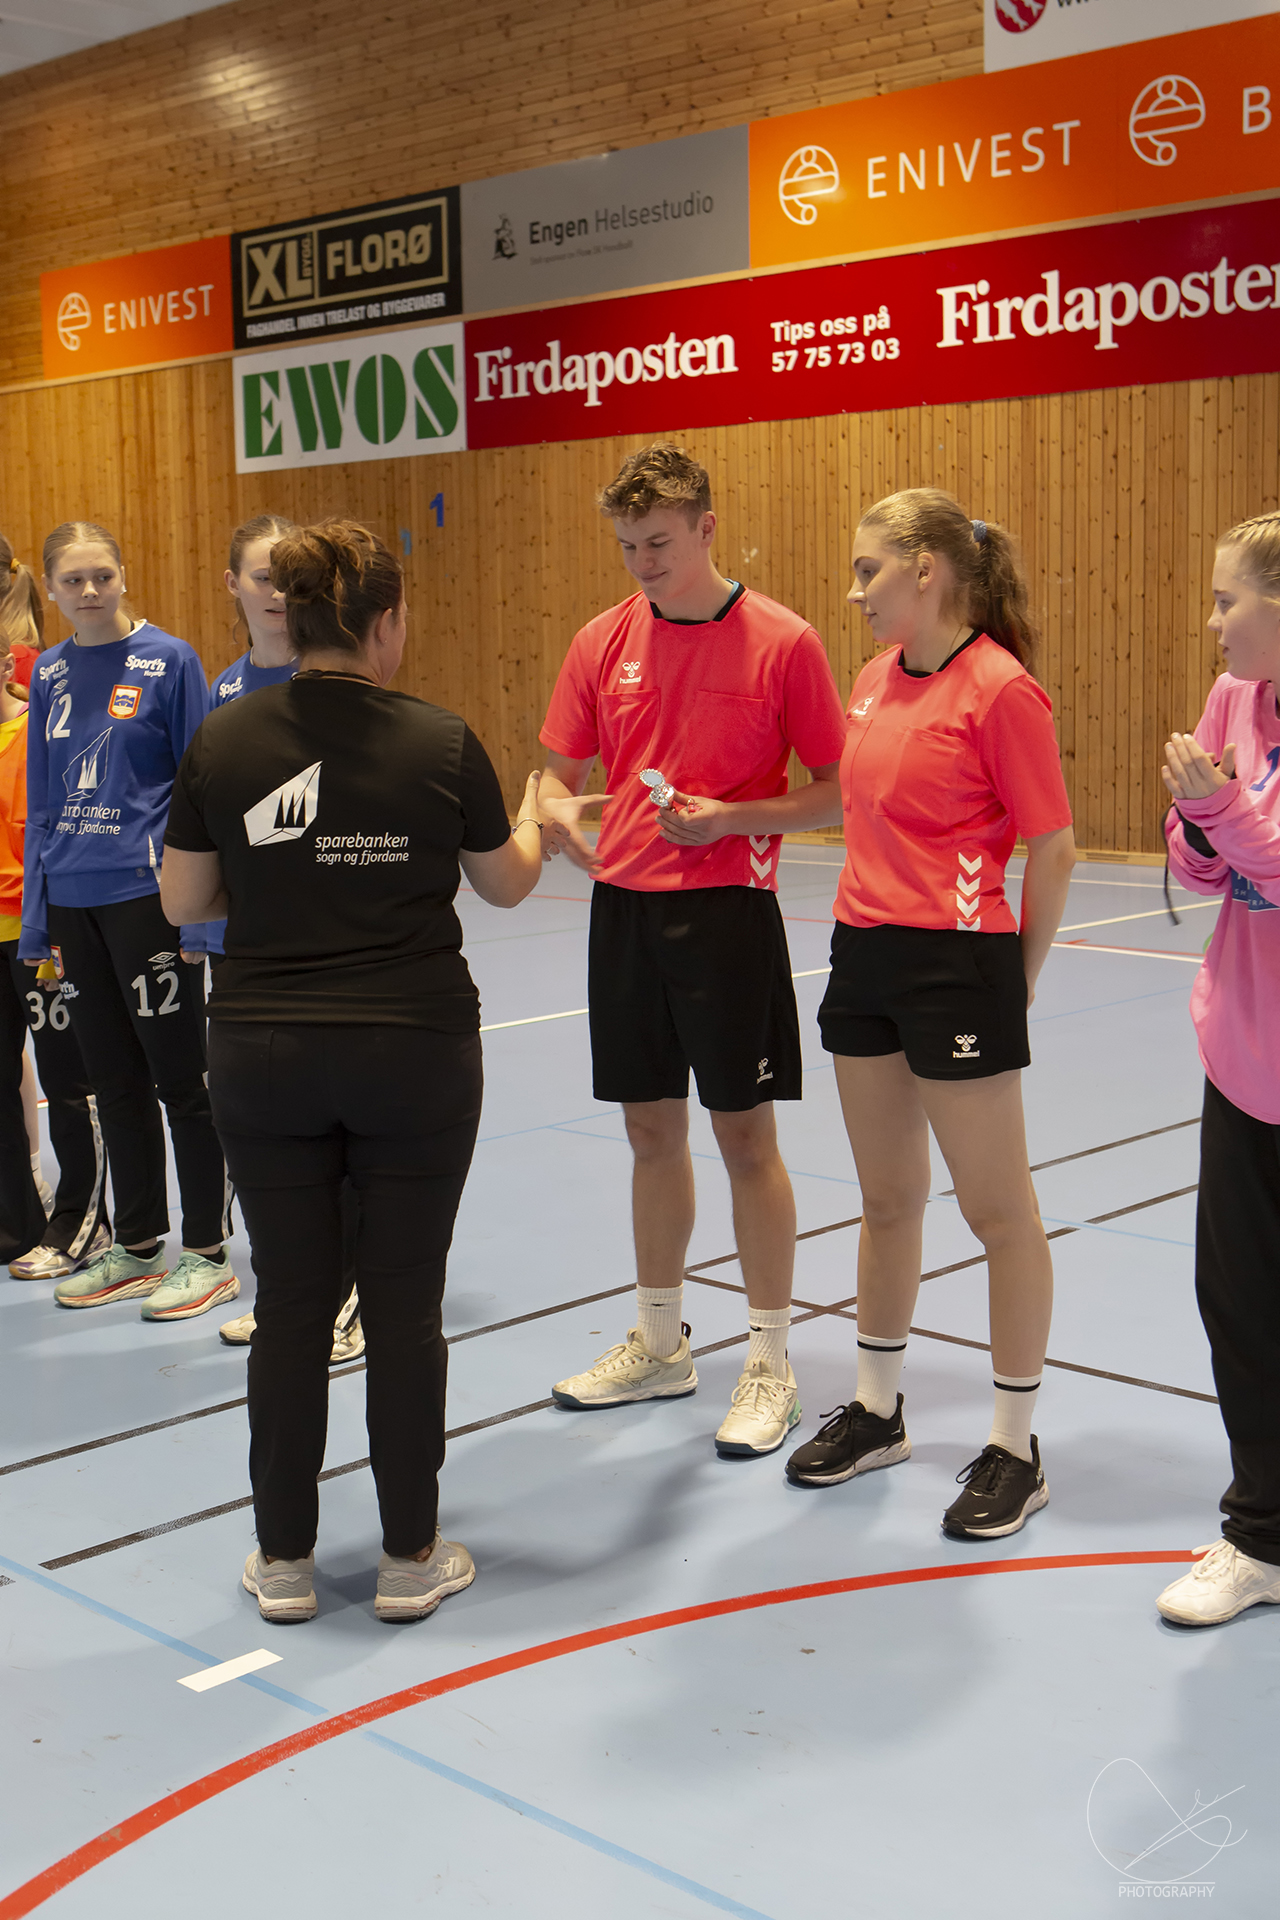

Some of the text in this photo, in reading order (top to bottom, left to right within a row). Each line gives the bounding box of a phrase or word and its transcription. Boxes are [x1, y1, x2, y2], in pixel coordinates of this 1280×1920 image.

[867, 120, 1081, 199] ENIVEST
[529, 191, 714, 246] Engen Helsestudio
[248, 239, 312, 306] XL
[326, 222, 432, 280] FLORØ
[104, 284, 214, 334] ENIVEST
[246, 317, 298, 339] FAGHANDEL
[326, 305, 366, 326] TRELAST
[366, 303, 382, 318] OG
[382, 292, 446, 317] BYGGEVARER
[770, 305, 891, 346] Tips oss på
[474, 331, 739, 407] Firdaposten
[771, 337, 900, 373] 57 75 73 03
[242, 343, 459, 459] EWOS
[429, 492, 444, 527] 1
[315, 832, 409, 851] sparebanken
[315, 850, 409, 866] sogn og fjordane
[25, 991, 70, 1031] 36
[131, 971, 181, 1017] 12
